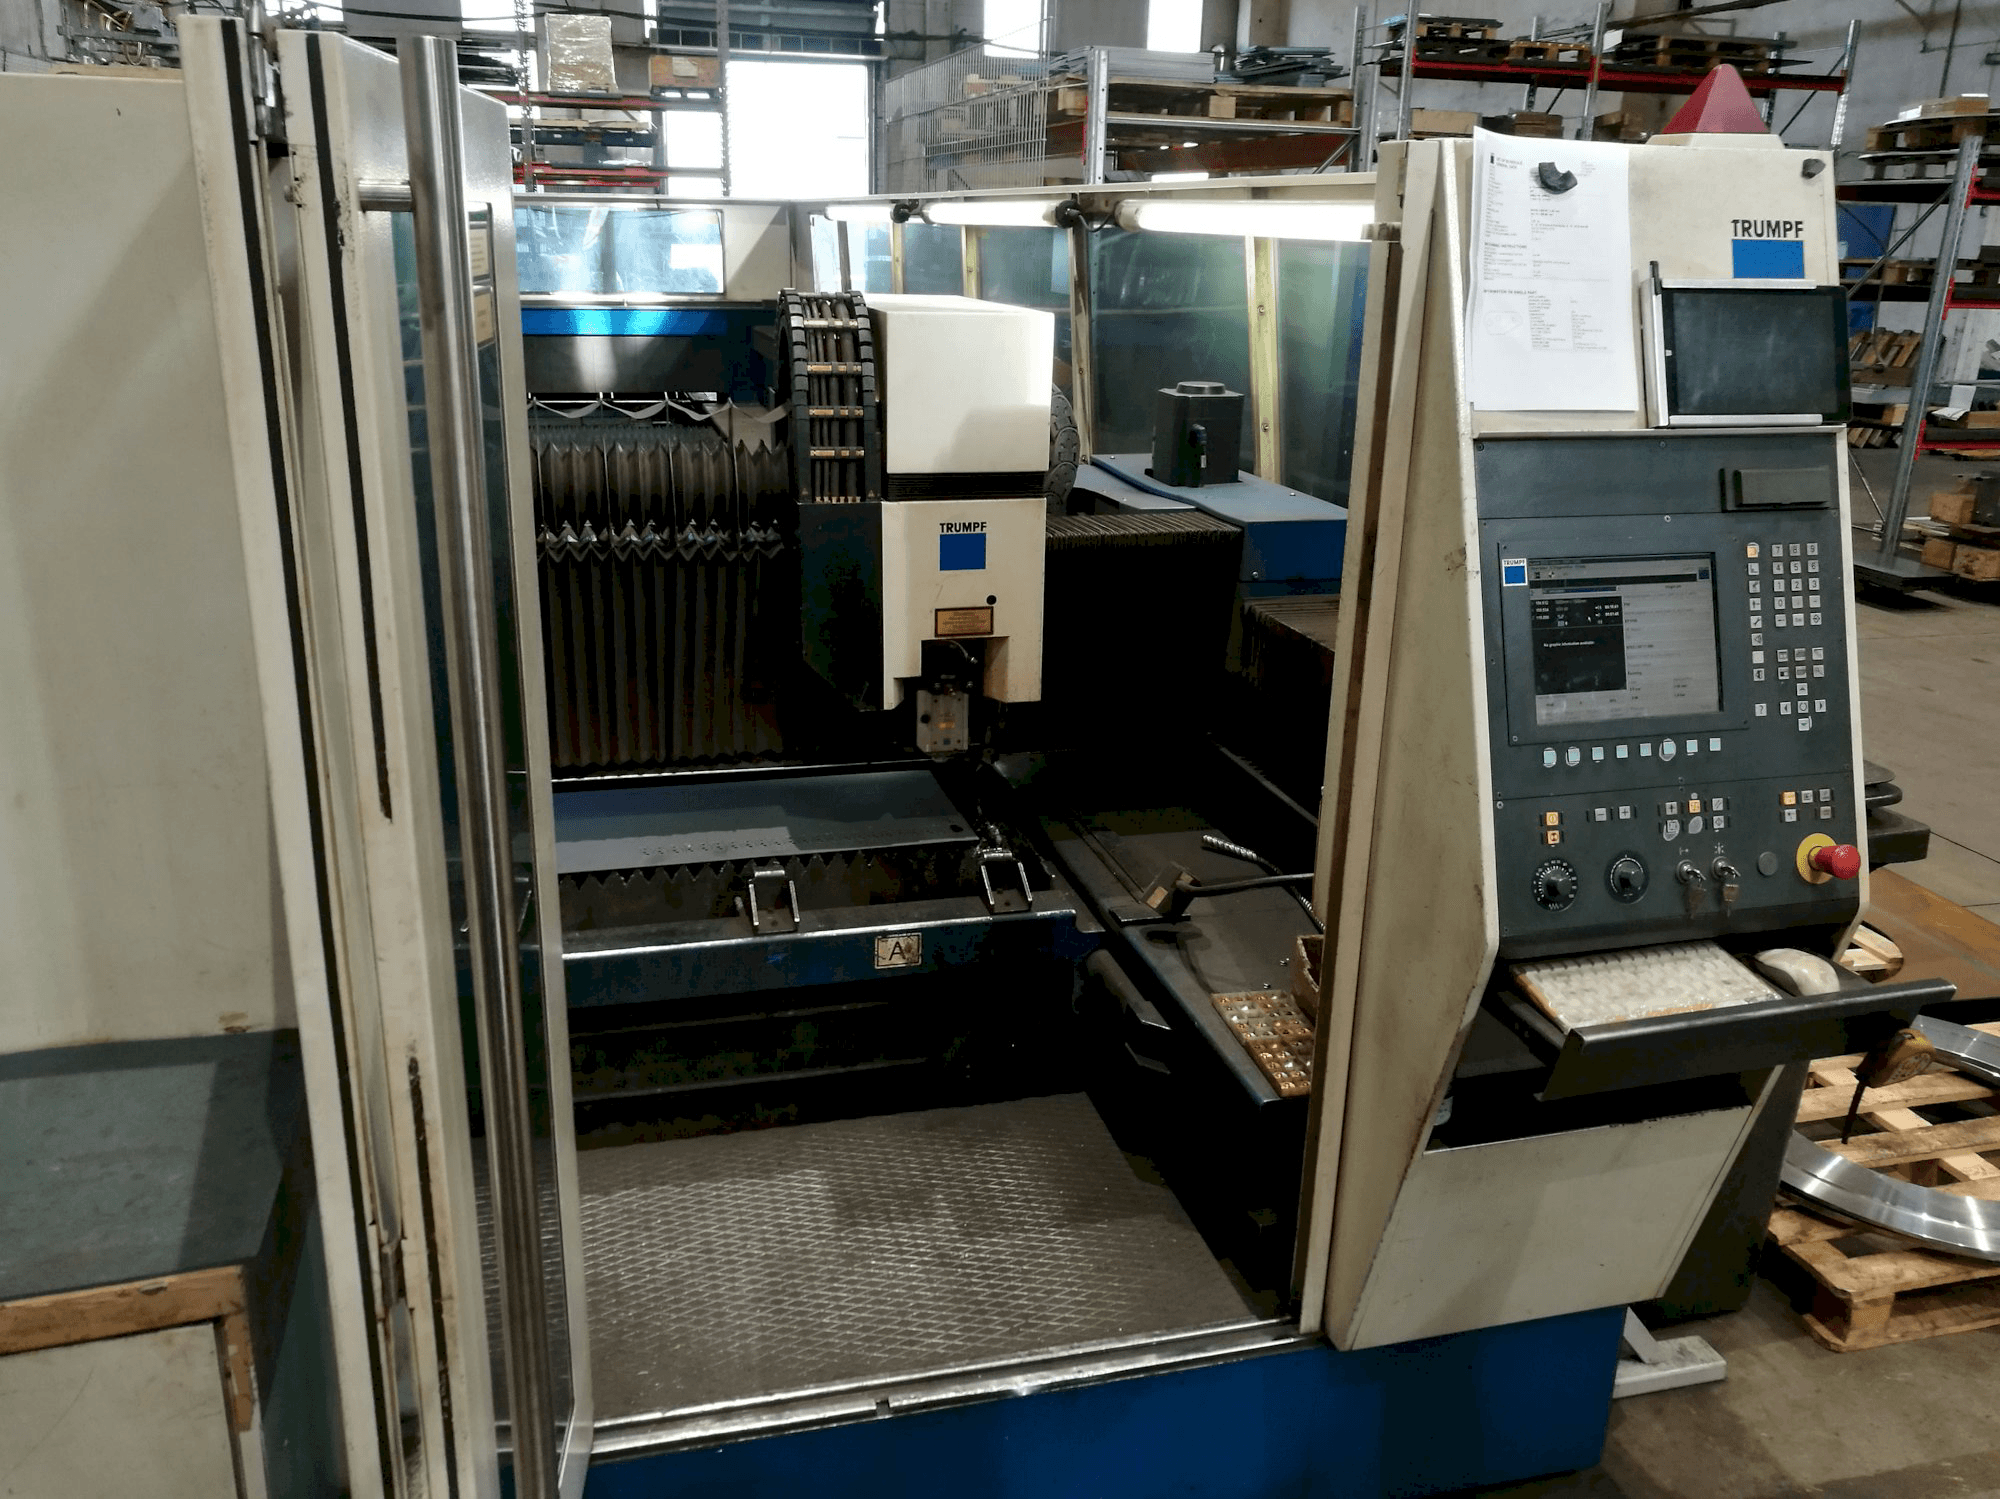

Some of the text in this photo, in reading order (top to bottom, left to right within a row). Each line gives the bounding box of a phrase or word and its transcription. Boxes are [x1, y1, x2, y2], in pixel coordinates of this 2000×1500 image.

[1731, 219, 1804, 238] TRUMPF
[939, 521, 987, 533] TRUMPF
[888, 941, 906, 961] A
